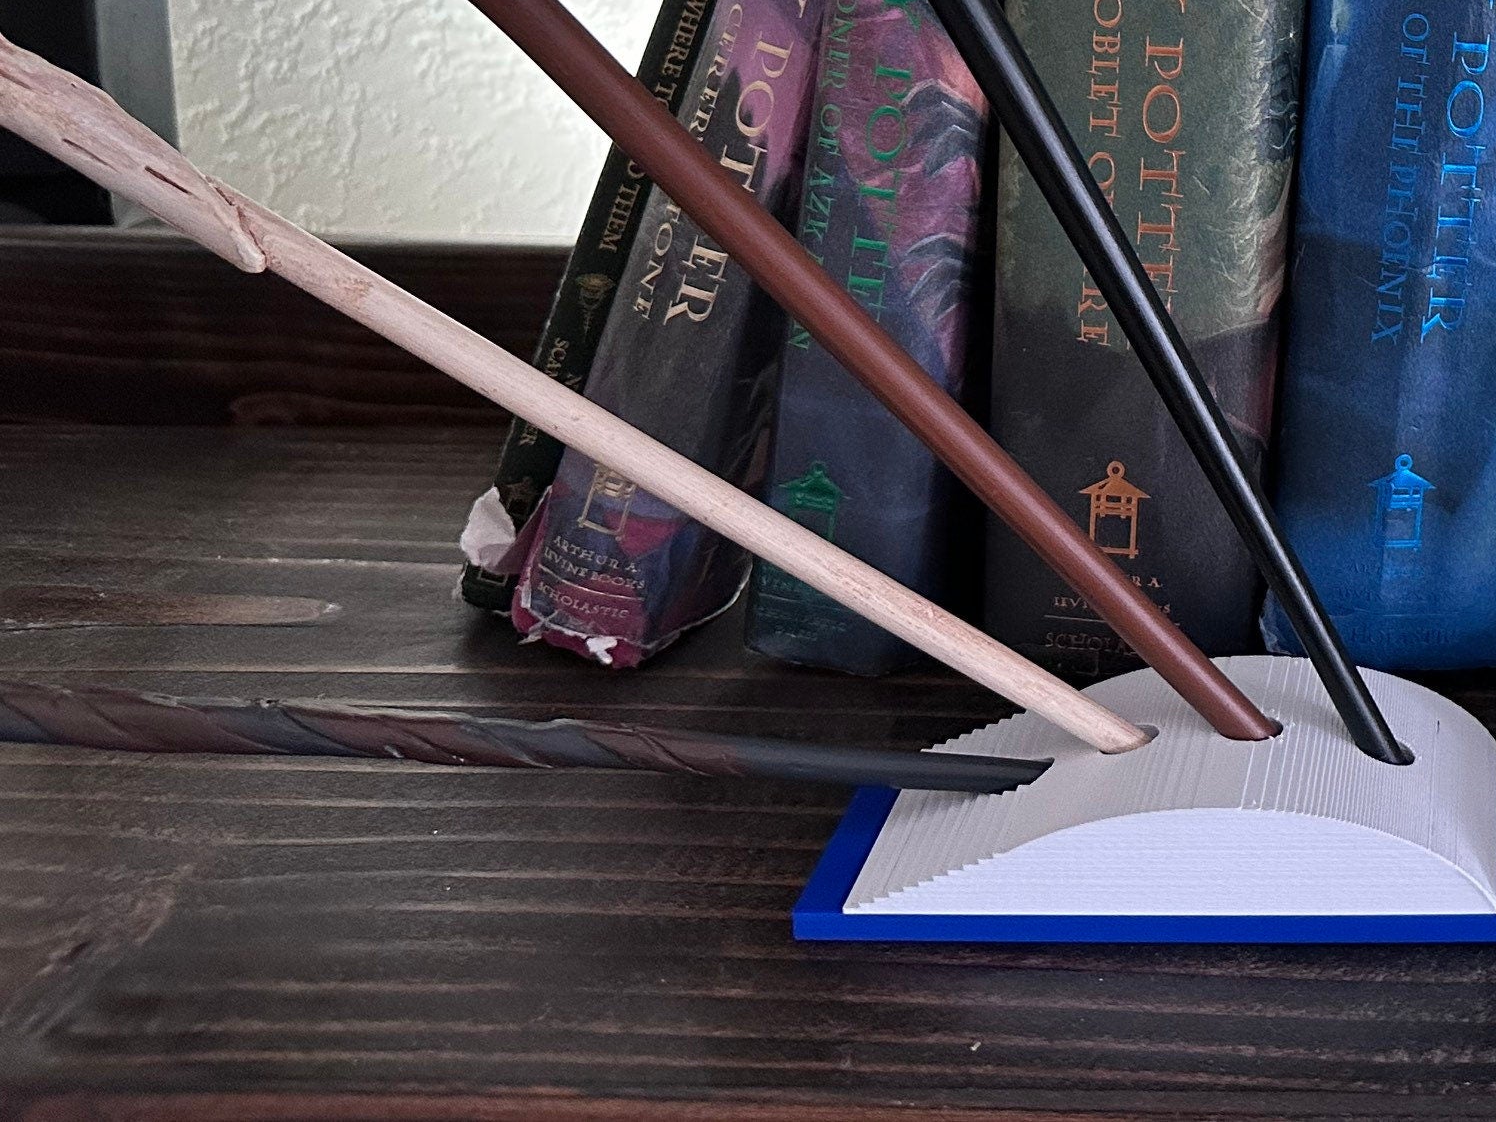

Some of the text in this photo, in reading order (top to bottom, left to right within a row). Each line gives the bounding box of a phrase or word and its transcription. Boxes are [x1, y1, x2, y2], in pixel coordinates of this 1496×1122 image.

[1398, 12, 1432, 66] OF
[815, 103, 843, 158] OF
[1387, 74, 1428, 155] THE
[599, 182, 641, 253] THEM
[662, 30, 795, 327] POTER
[1128, 35, 1187, 350] POTTE
[1420, 32, 1492, 345] POTTER
[1371, 161, 1420, 345] PHOENIX
[552, 535, 620, 570] ARTHUR
